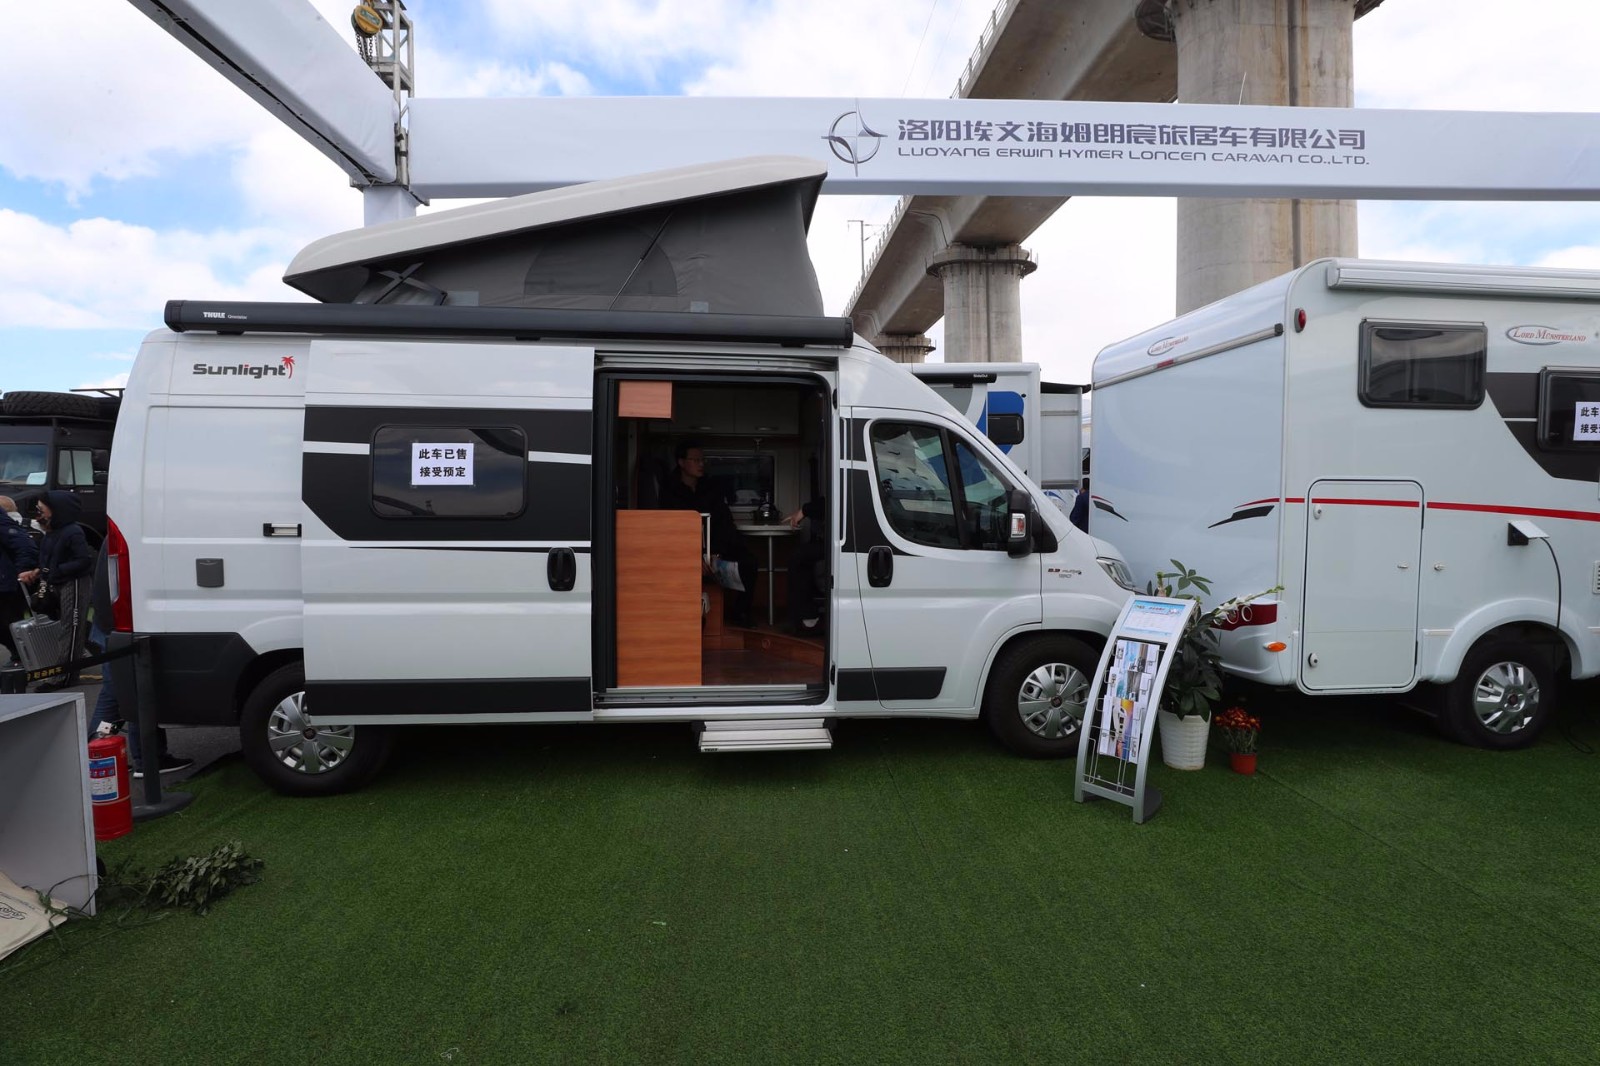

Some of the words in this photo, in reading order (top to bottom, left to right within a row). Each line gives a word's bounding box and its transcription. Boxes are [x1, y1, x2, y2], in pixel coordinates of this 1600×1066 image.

[898, 119, 1366, 150] 洛阳埃文海姆朗宸旅居车有限公司
[898, 147, 990, 157] LUOYANG
[996, 148, 1053, 158] ERWIN
[1059, 149, 1123, 159] HYMER
[1129, 150, 1206, 161] LONCEN
[1211, 152, 1293, 163] CARAVAN
[203, 311, 225, 319] THULE
[192, 363, 286, 379] Sunlight
[1580, 423, 1600, 434] 接受
[419, 448, 467, 460] 此车已售
[419, 466, 466, 477] 接受预定
